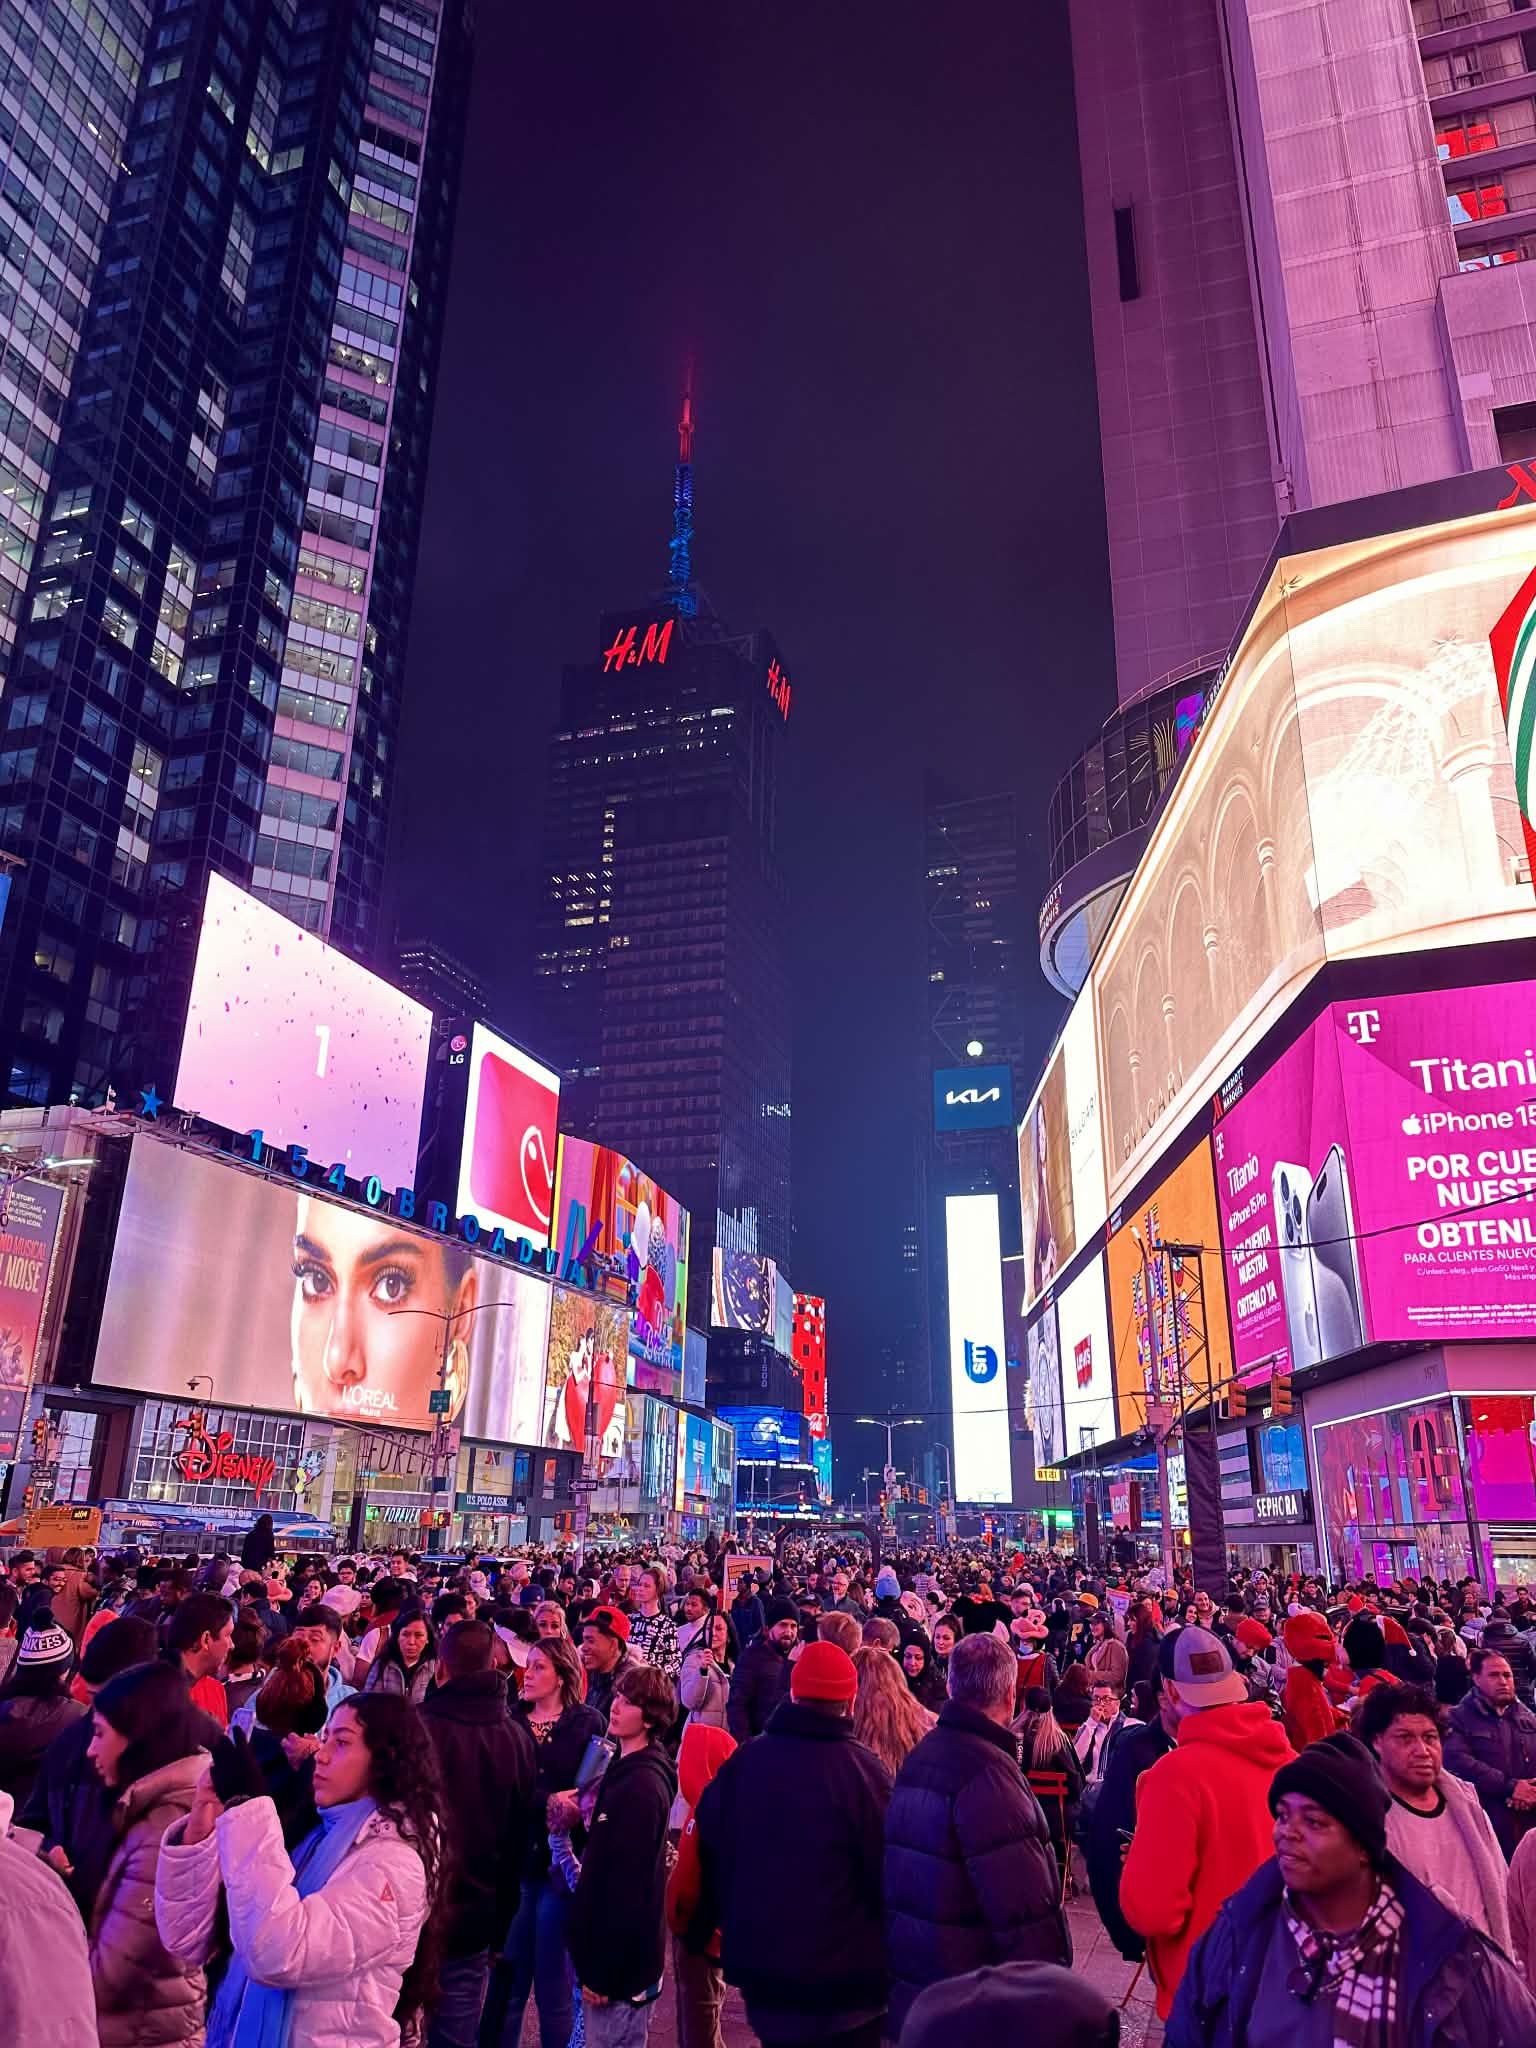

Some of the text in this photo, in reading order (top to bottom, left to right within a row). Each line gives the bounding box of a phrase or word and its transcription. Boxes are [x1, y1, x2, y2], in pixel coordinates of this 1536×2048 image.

[604, 620, 675, 672] H&M
[767, 658, 791, 721] H&M
[315, 1025, 331, 1079] 1
[450, 1054, 464, 1065] LG
[946, 1087, 1000, 1105] KIA
[1423, 1111, 1514, 1134] iPhone
[1226, 1153, 1259, 1197] Titanio
[1407, 1153, 1471, 1181] POR
[1238, 1250, 1269, 1287] NUESTRA
[1404, 1253, 1436, 1264] PARA
[1437, 1250, 1494, 1263] CLIENTES
[5, 1255, 43, 1293] NOISE
[1265, 1279, 1278, 1303] YA
[477, 1496, 492, 1506] POLO
[1256, 1494, 1298, 1518] SEPHORA
